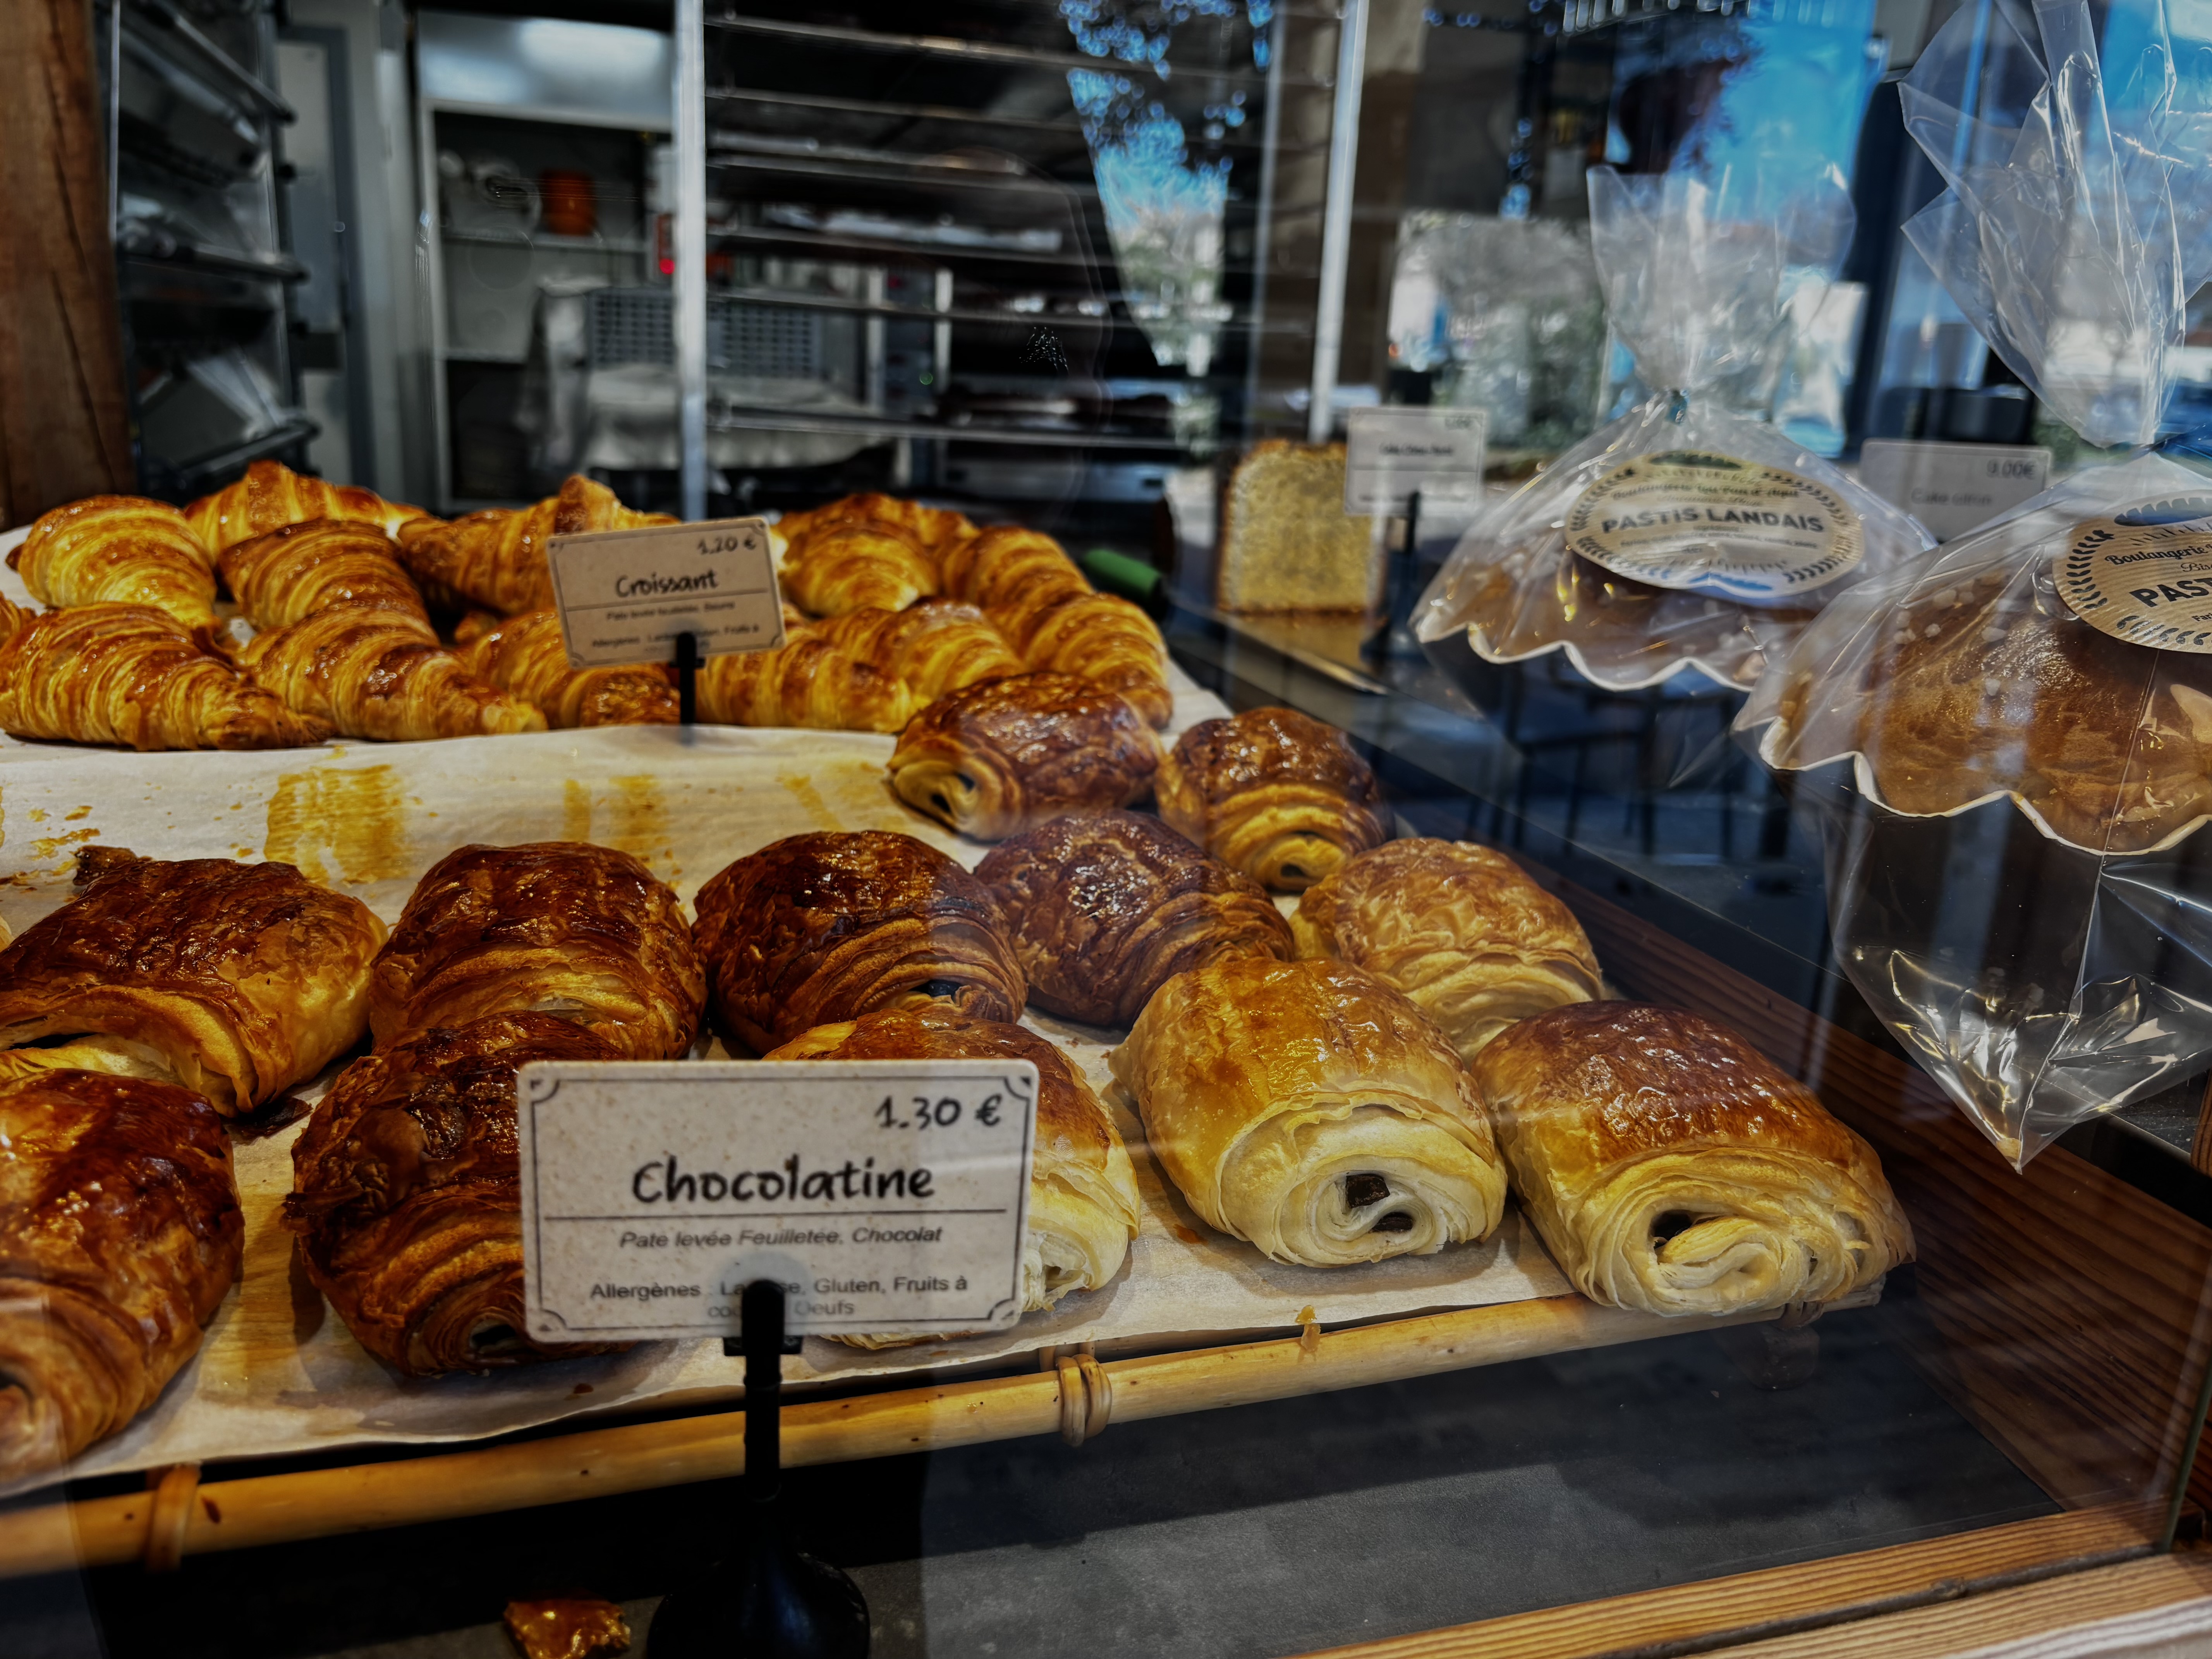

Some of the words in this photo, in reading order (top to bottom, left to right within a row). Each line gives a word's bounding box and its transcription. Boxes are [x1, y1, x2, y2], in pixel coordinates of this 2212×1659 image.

[1602, 508, 1698, 534] PASTIS
[1705, 508, 1824, 533] LANDAIS
[697, 537, 738, 555] 1.20
[2104, 546, 2208, 565] Boulangerie
[615, 568, 719, 597] Croissant
[874, 1095, 962, 1130] 1.30
[975, 1093, 1002, 1127] €
[632, 1153, 934, 1203] Chocolatine
[620, 1231, 669, 1248] Pate
[675, 1230, 733, 1247] levée
[853, 1226, 943, 1242] Chocolat
[589, 1283, 701, 1301] Allergènes
[814, 1279, 886, 1293] Gluten,
[893, 1276, 949, 1292] Fruits
[956, 1275, 968, 1291] à
